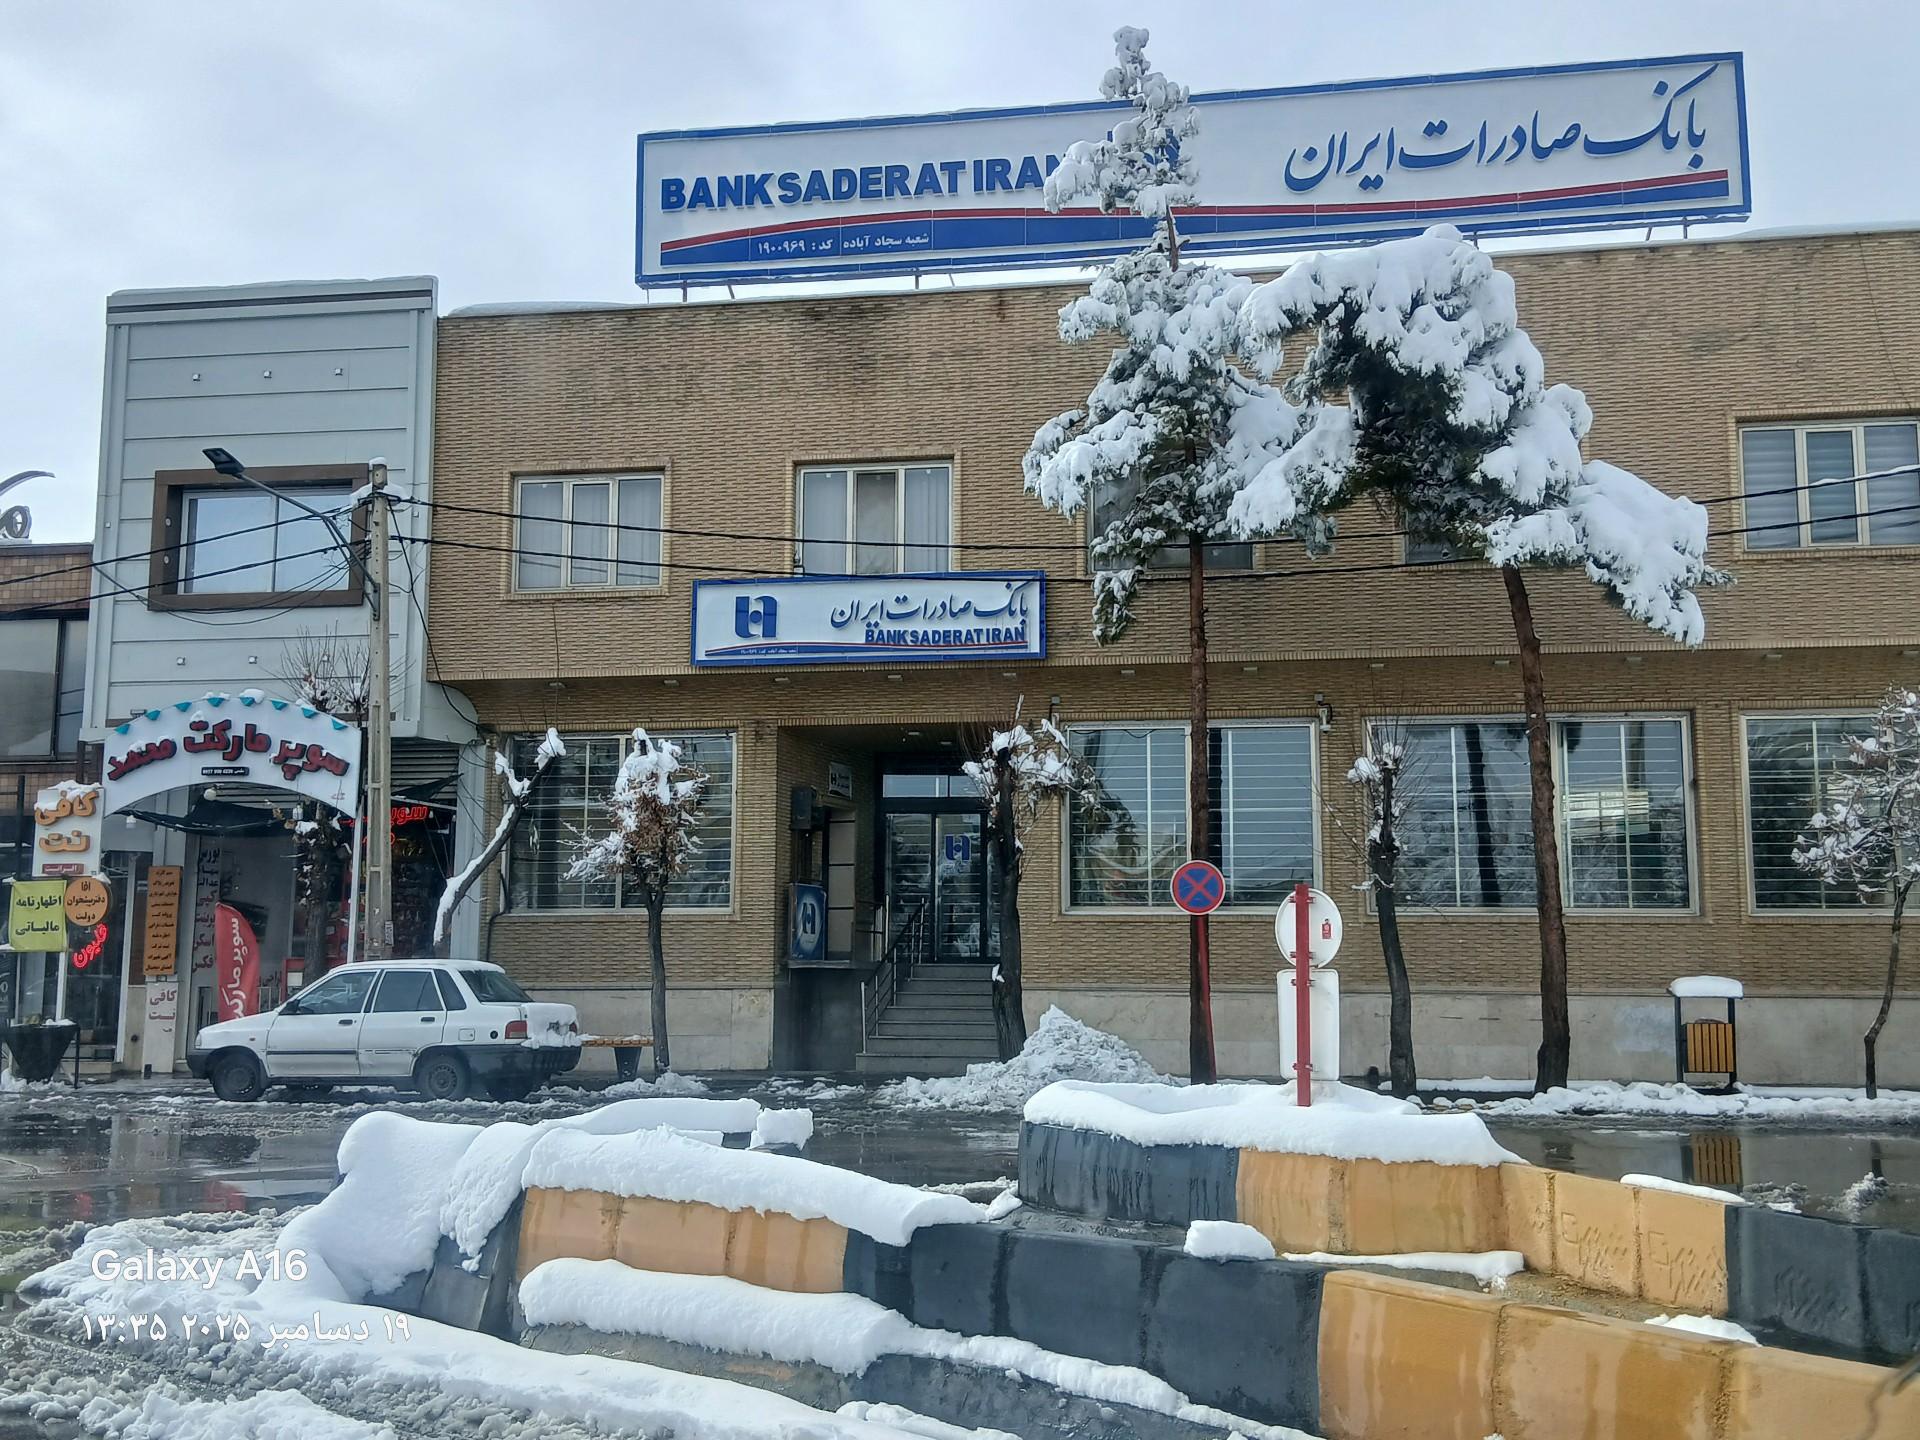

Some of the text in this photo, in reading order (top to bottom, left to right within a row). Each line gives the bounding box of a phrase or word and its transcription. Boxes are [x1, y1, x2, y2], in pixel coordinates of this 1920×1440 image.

[1283, 63, 1719, 193] بانک صادرات ایران
[661, 172, 776, 212] BANK
[777, 160, 967, 206] SADERAT
[757, 241, 806, 255] ۱۹۰۰۹۶۹
[843, 235, 871, 248] آباده
[874, 235, 903, 248] سجاد
[905, 233, 929, 247] شعبه
[830, 580, 1034, 629] بانک صادرات ایران
[865, 627, 1025, 645] BANK SADERAT IRAN
[183, 718, 272, 762] مارکت
[270, 739, 350, 781] سوپر
[35, 790, 99, 826] کافی
[39, 829, 90, 852] نت
[75, 912, 96, 922] دولت
[15, 921, 60, 936] مالیاتی
[150, 988, 177, 1006] کافی
[221, 966, 247, 1019] مارک
[149, 1008, 176, 1020] نت
